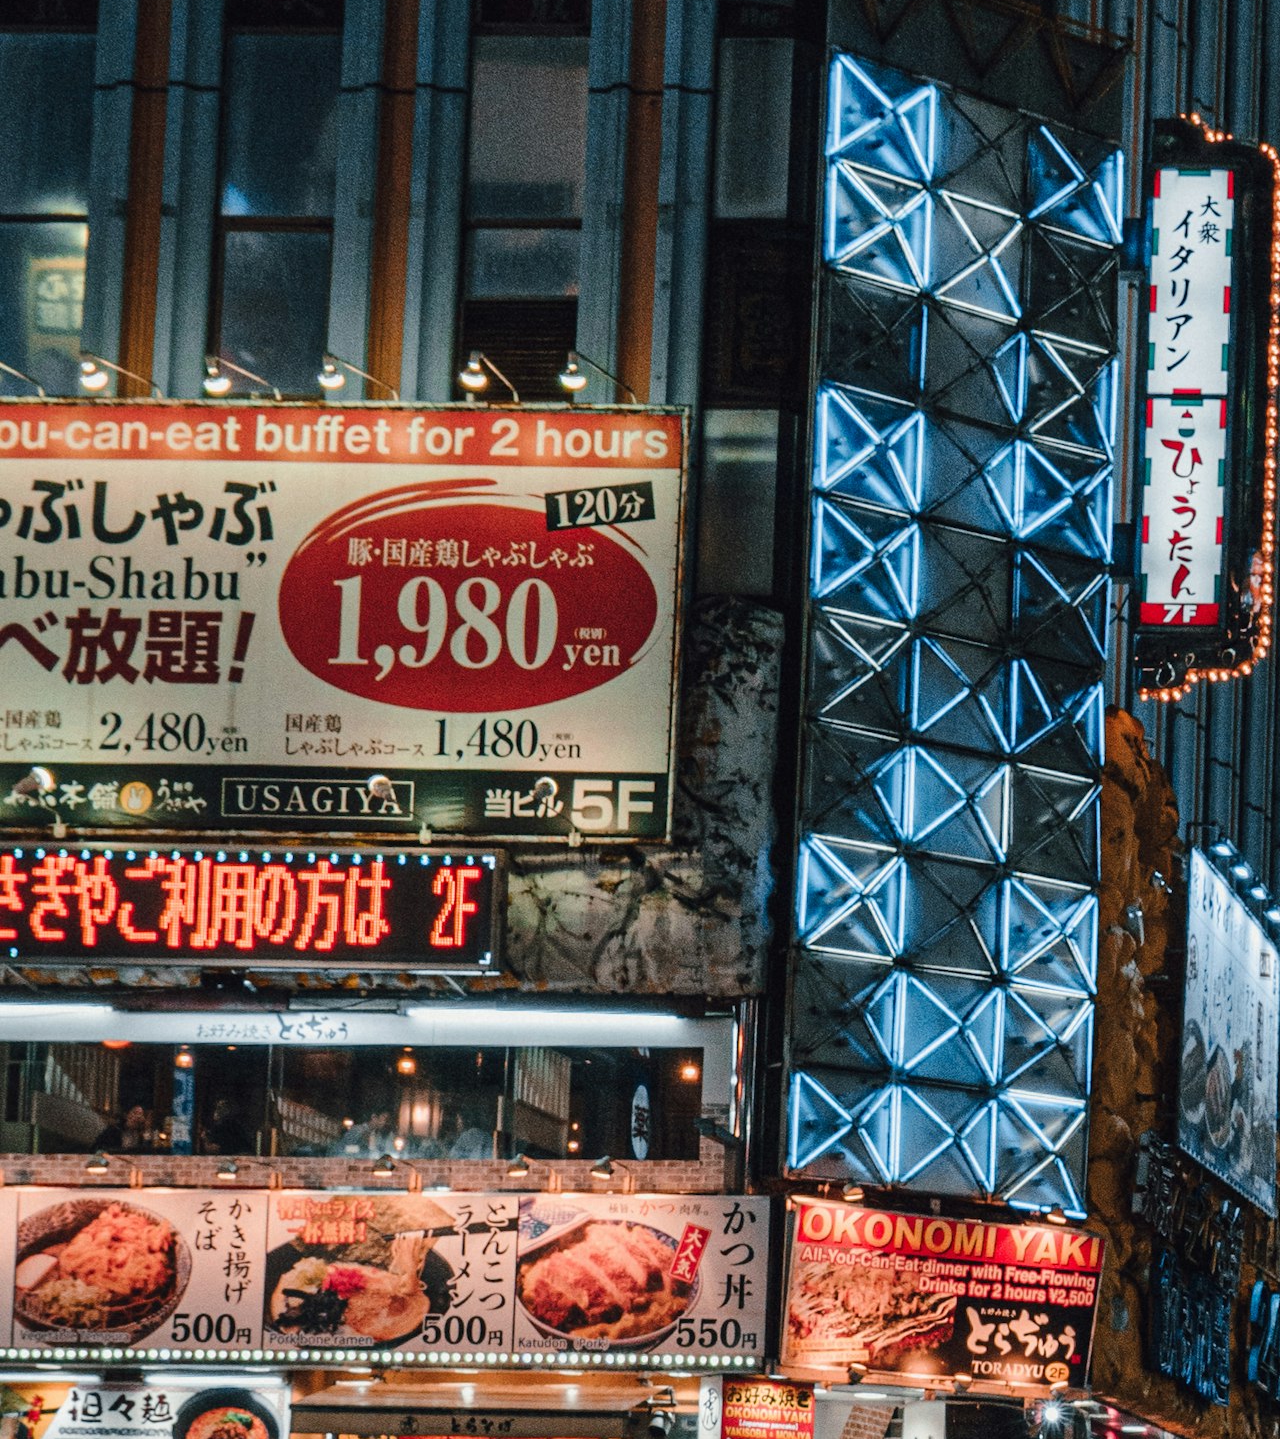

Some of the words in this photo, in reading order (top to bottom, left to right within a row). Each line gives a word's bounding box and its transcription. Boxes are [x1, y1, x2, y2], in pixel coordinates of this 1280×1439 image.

[1199, 195, 1221, 244] 大衆
[1166, 210, 1194, 373] イタリアン
[256, 415, 389, 456] buffet
[408, 418, 473, 455] for
[491, 420, 520, 455] 2
[536, 420, 669, 460] hours
[554, 487, 645, 528] 120分
[1160, 438, 1203, 601] ひょうたん
[328, 575, 558, 681] 1,980
[564, 642, 621, 671] yen
[1162, 603, 1197, 624] 7F
[100, 712, 206, 756] 2,480
[206, 734, 248, 756] yen
[433, 718, 539, 762] 1,480
[539, 740, 581, 762] yen
[236, 784, 402, 815] USAGIYA
[572, 781, 655, 831] 5F
[430, 867, 481, 948] 2F
[195, 1201, 218, 1251] そば
[801, 1208, 997, 1258] OKONOMI
[1009, 1227, 1100, 1269] YAKI
[223, 1198, 253, 1304] かき揚げ
[448, 1205, 473, 1309] ラーメン
[479, 1202, 509, 1311] とんこつ
[716, 1201, 757, 1311] かつ丼
[801, 1246, 923, 1273] All-You-Can-Eat
[922, 1257, 970, 1278] dinner
[971, 1262, 1002, 1281] with
[1004, 1266, 1096, 1291] Free-Flowing
[919, 1275, 966, 1296] Drinks
[968, 1279, 990, 1297] for
[992, 1282, 1002, 1299] 2
[1004, 1284, 1046, 1303] hours
[171, 1313, 252, 1345] 500円
[422, 1315, 504, 1347] 500円
[676, 1317, 758, 1349] 550円
[971, 1359, 1044, 1380] TORADYU
[1048, 1366, 1067, 1380] 2F
